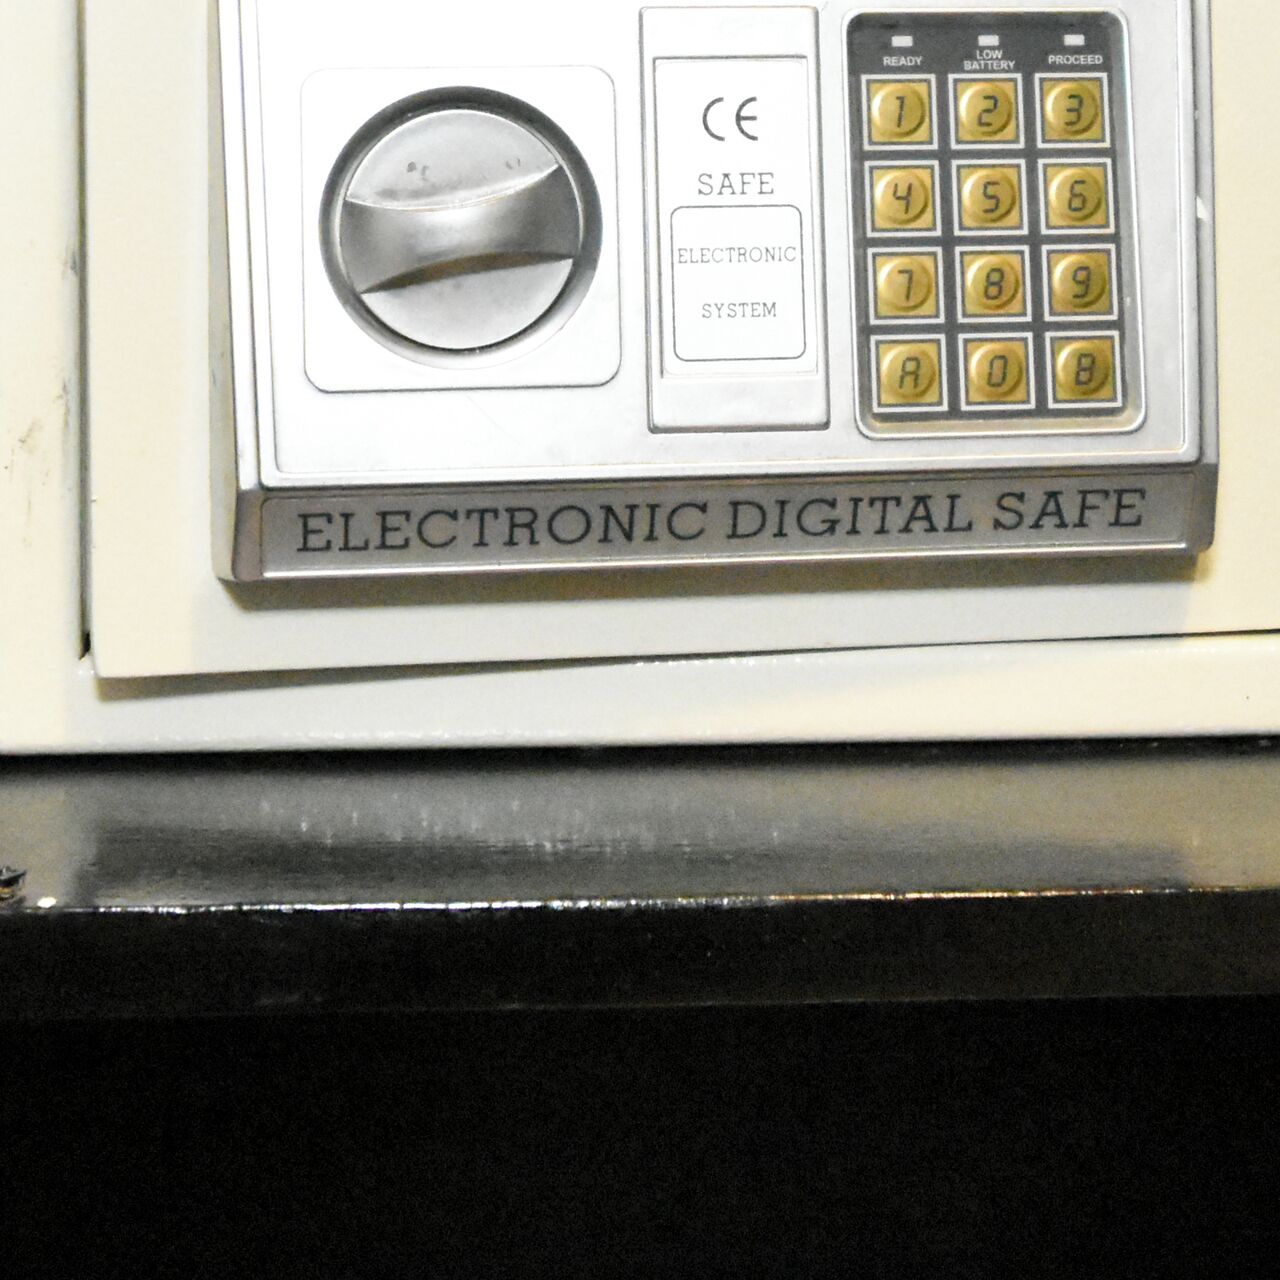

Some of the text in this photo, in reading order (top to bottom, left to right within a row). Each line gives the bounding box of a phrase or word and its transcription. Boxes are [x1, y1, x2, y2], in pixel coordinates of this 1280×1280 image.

[883, 55, 922, 67] READY
[963, 60, 1016, 71] BATTERY
[976, 49, 1003, 60] LOW
[1048, 54, 1103, 66] PROCEED
[702, 96, 759, 142] CE
[895, 95, 905, 128] 1
[977, 94, 999, 128] 2
[1064, 94, 1084, 127] 3
[697, 172, 775, 196] SAFE
[892, 182, 913, 215] 4
[982, 180, 1001, 214] 5
[1067, 179, 1087, 213] 6
[677, 246, 797, 264] ELECTRONIC
[897, 269, 914, 302] 7
[983, 267, 1005, 301] 8
[1072, 265, 1092, 299] 9
[701, 301, 777, 319] SYSTEM
[898, 356, 921, 390] A
[987, 354, 1008, 388] 0
[295, 487, 1148, 555] ELECTRONIC DIGITAL SAFE
